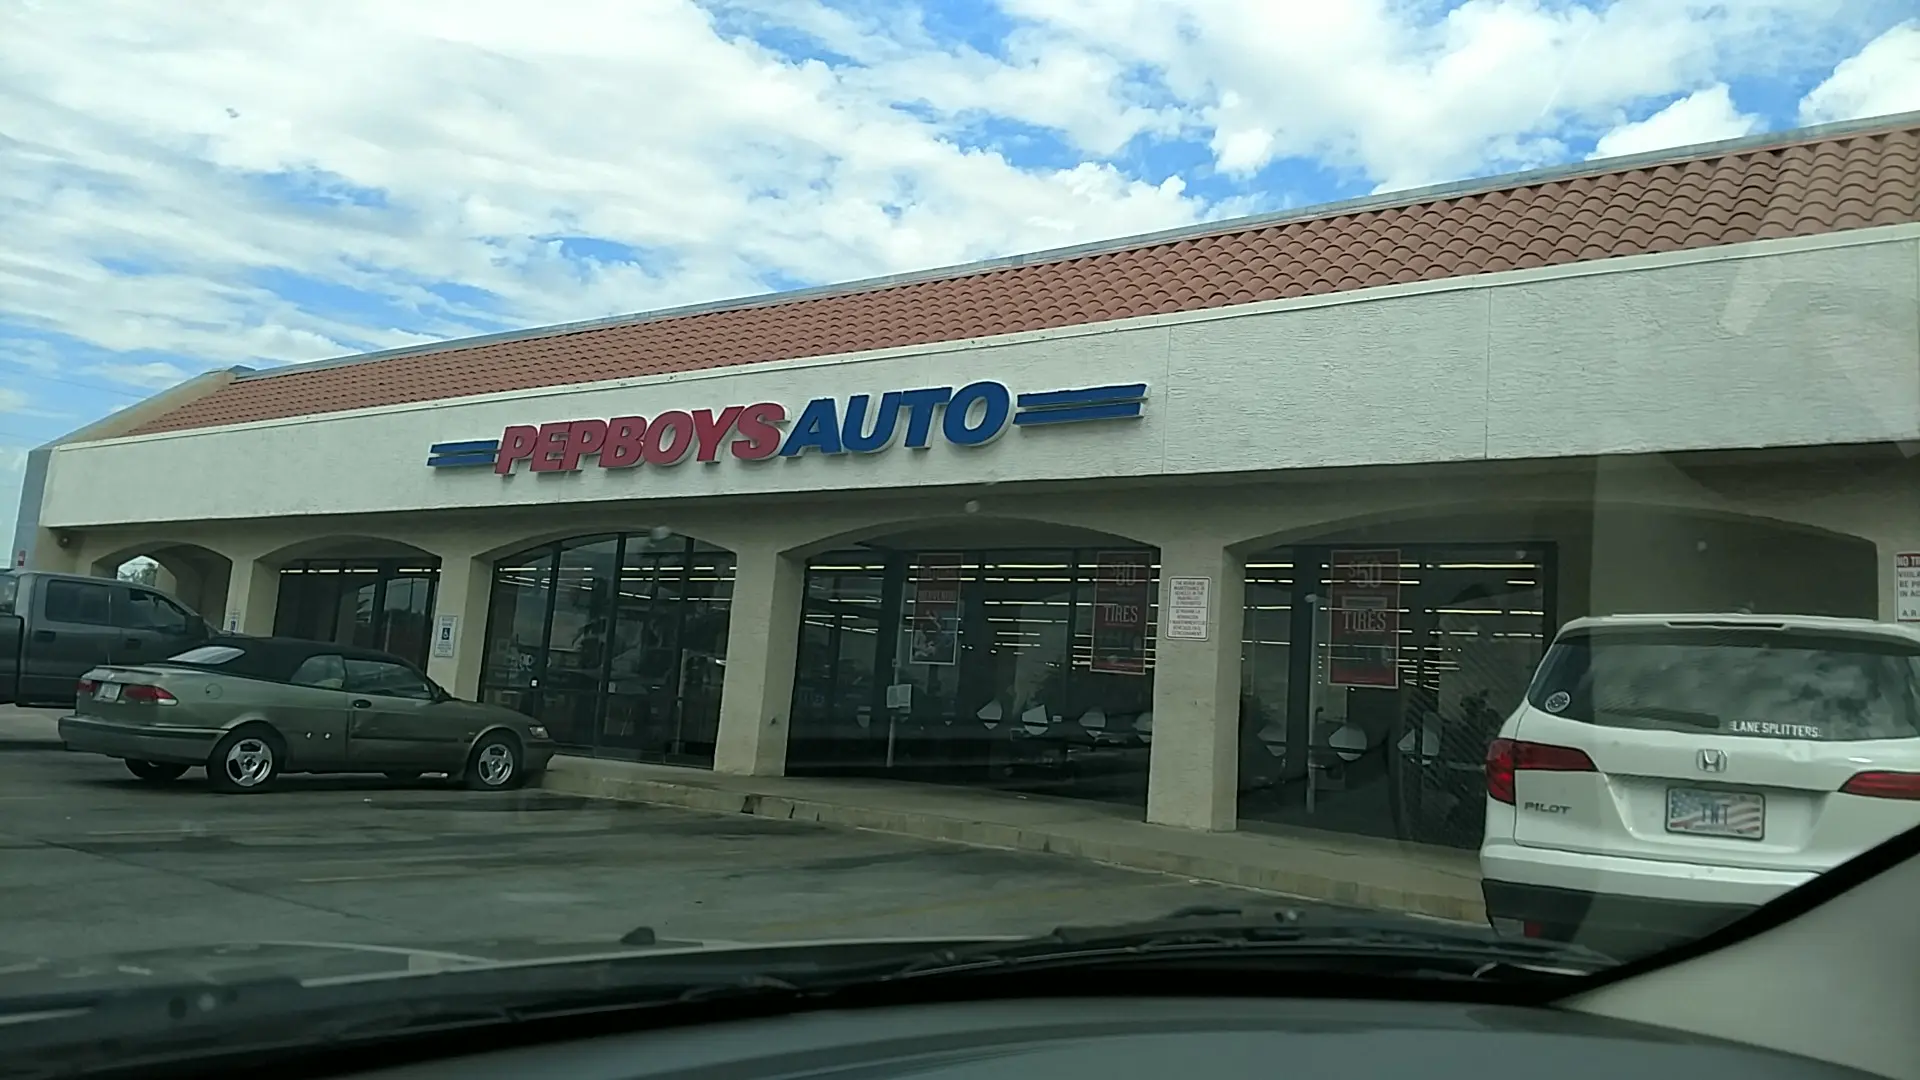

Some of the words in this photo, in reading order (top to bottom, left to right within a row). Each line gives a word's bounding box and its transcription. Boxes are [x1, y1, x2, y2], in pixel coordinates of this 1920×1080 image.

[778, 380, 1011, 457] AUTO
[1103, 604, 1138, 623] TIRES
[1341, 611, 1387, 630] TIRES
[1733, 720, 1761, 733] LANE
[1761, 721, 1819, 737] SPLITTERS
[1523, 801, 1573, 814] PILOT
